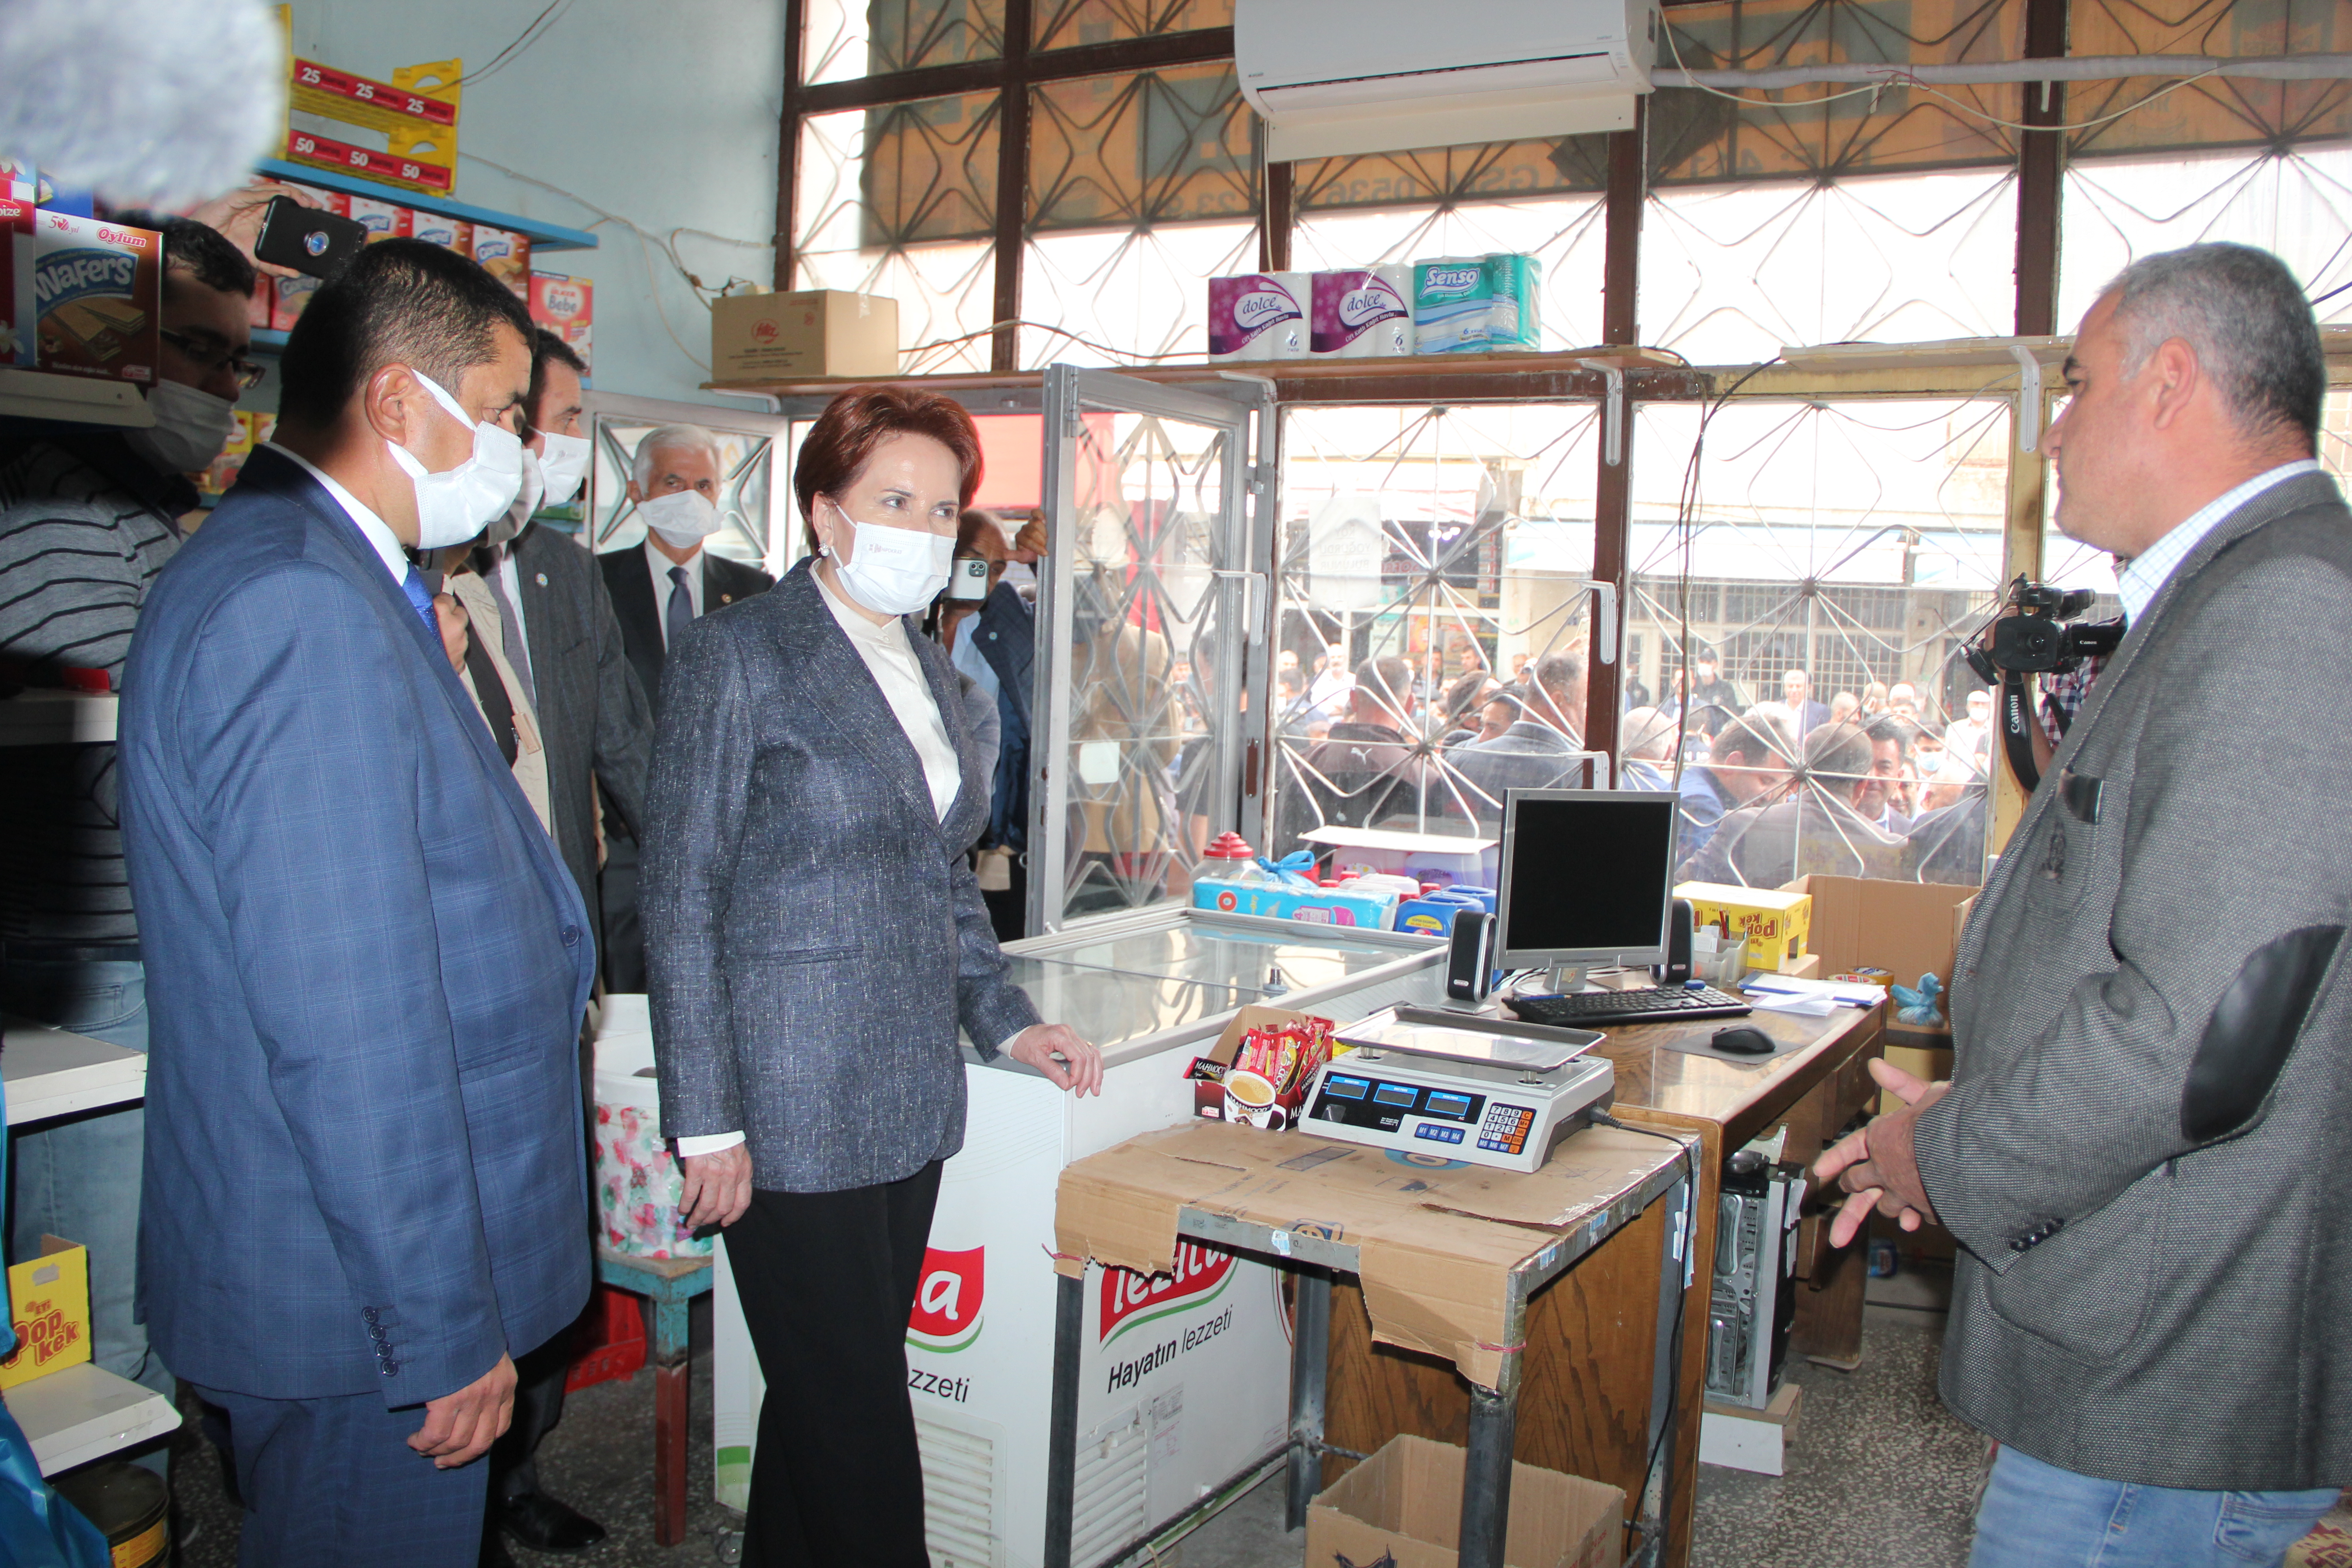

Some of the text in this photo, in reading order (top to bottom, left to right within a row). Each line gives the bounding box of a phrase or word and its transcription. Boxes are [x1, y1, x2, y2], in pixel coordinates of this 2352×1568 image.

[302, 67, 321, 84] 25
[356, 83, 374, 99] 25
[407, 98, 424, 113] 25
[295, 137, 315, 153] 50
[350, 151, 368, 166] 50
[402, 164, 420, 179] 50
[98, 228, 147, 248] Oylum
[1426, 267, 1480, 286] Senso
[548, 294, 577, 313] Bebe
[1243, 297, 1276, 314] dolce
[1348, 294, 1381, 312] dolce
[1395, 334, 1404, 346] 6
[2010, 695, 2020, 734] Canon
[1229, 1095, 1268, 1113] MAHMOOD
[36, 1321, 79, 1366] kek
[1107, 1304, 1234, 1394] Hayatın lezzeti
[908, 1368, 970, 1403] zzeti
